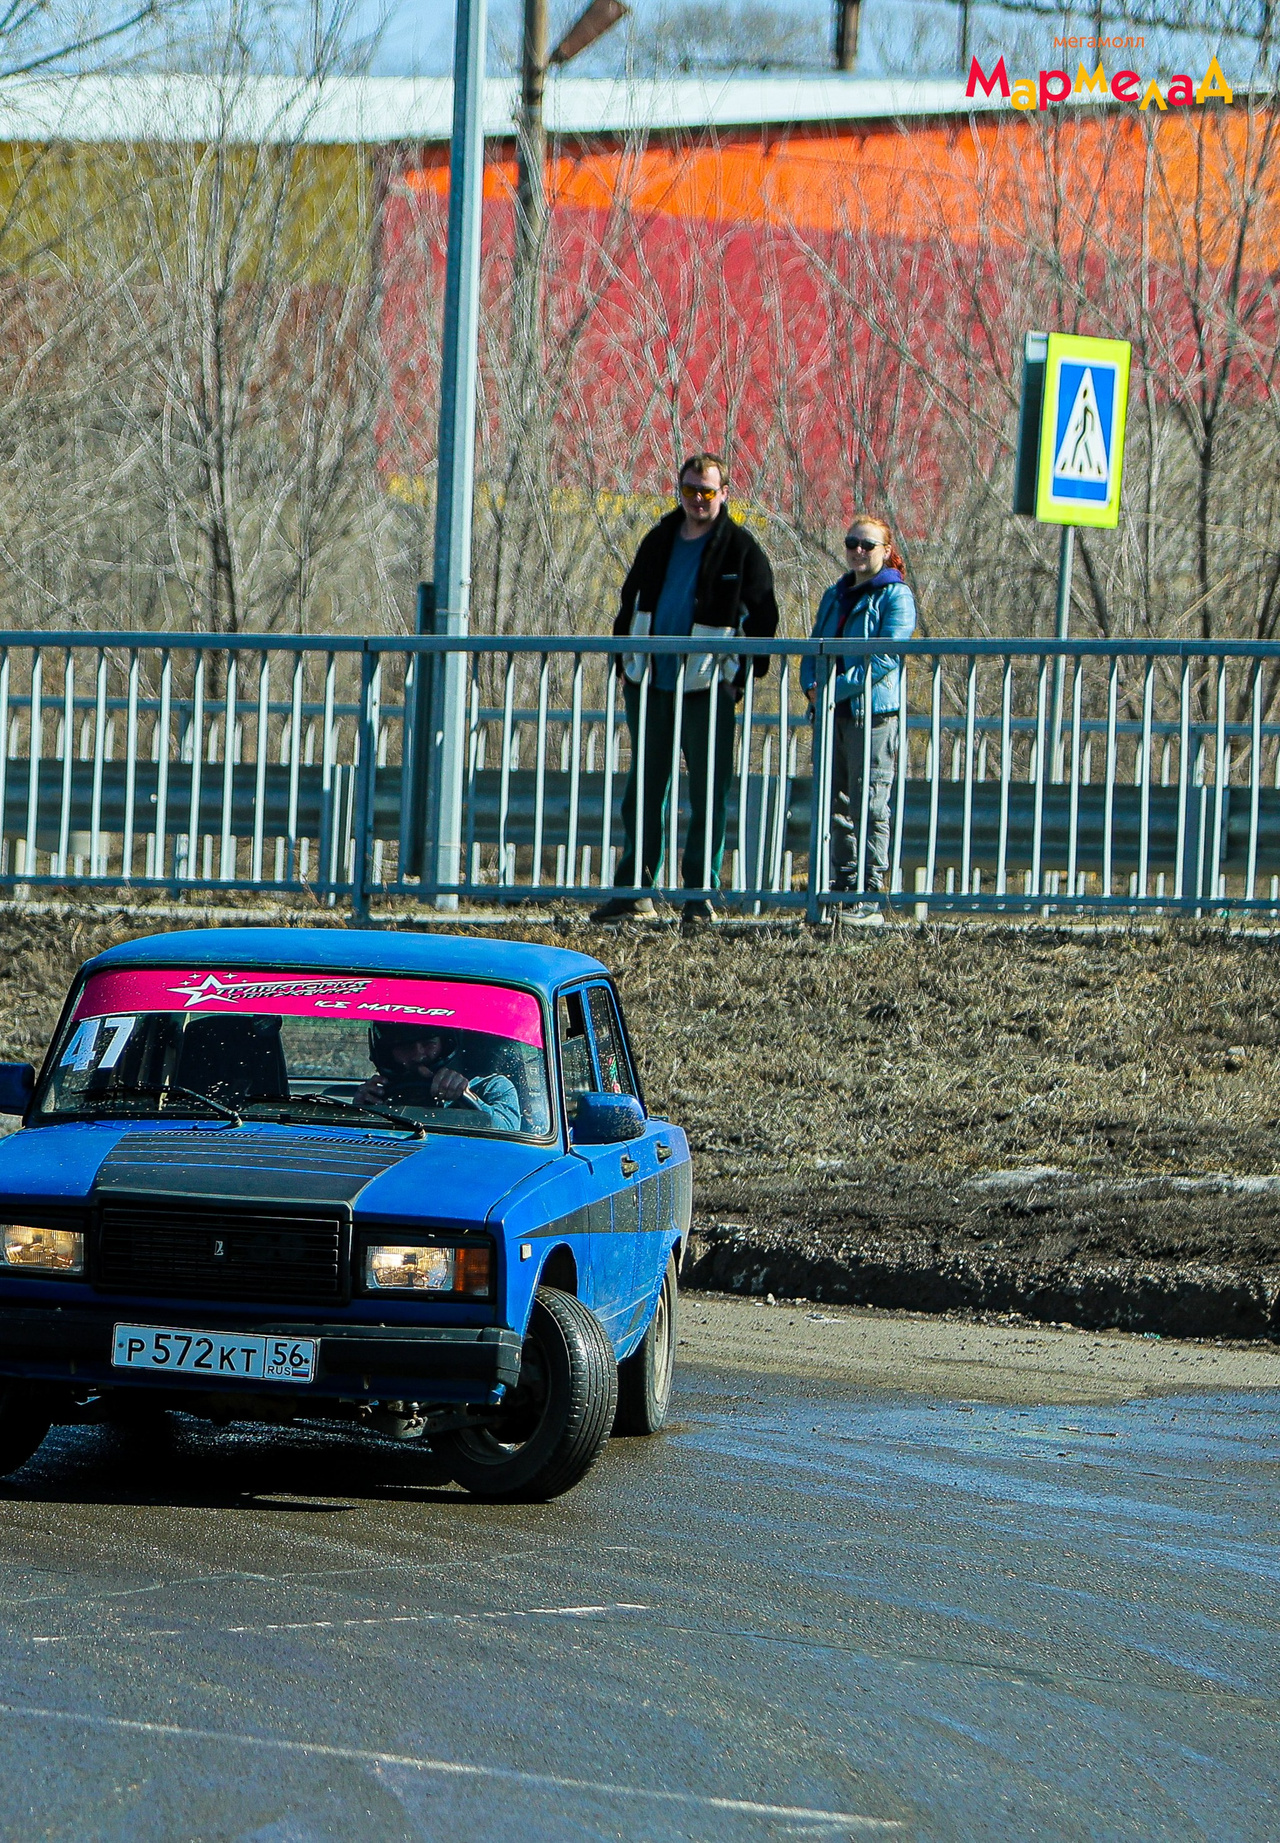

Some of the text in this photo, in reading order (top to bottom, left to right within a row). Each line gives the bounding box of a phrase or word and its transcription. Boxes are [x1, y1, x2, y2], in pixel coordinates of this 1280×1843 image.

[314, 1000, 456, 1017] ICE MATSURI
[60, 1017, 136, 1071] 47
[271, 1342, 304, 1367] 56
[267, 1365, 291, 1376] RUS
